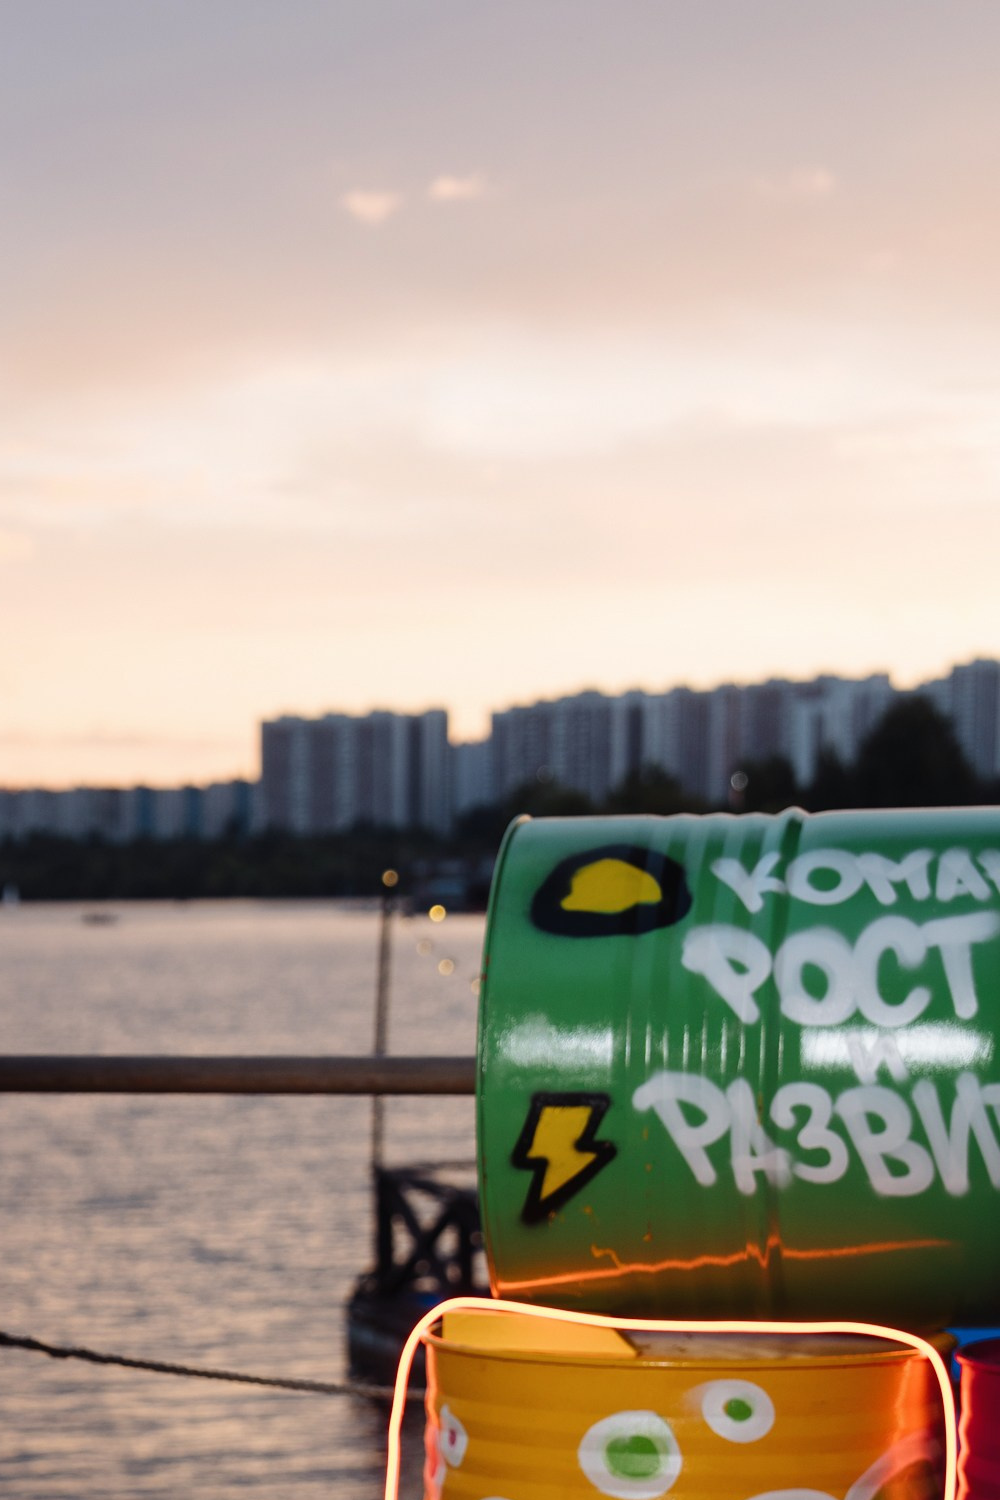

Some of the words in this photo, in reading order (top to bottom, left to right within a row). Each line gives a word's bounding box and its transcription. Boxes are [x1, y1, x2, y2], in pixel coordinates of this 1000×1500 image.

[711, 848, 1000, 912] КОМА
[682, 911, 999, 1025] РОСТ
[845, 1031, 908, 1084] И
